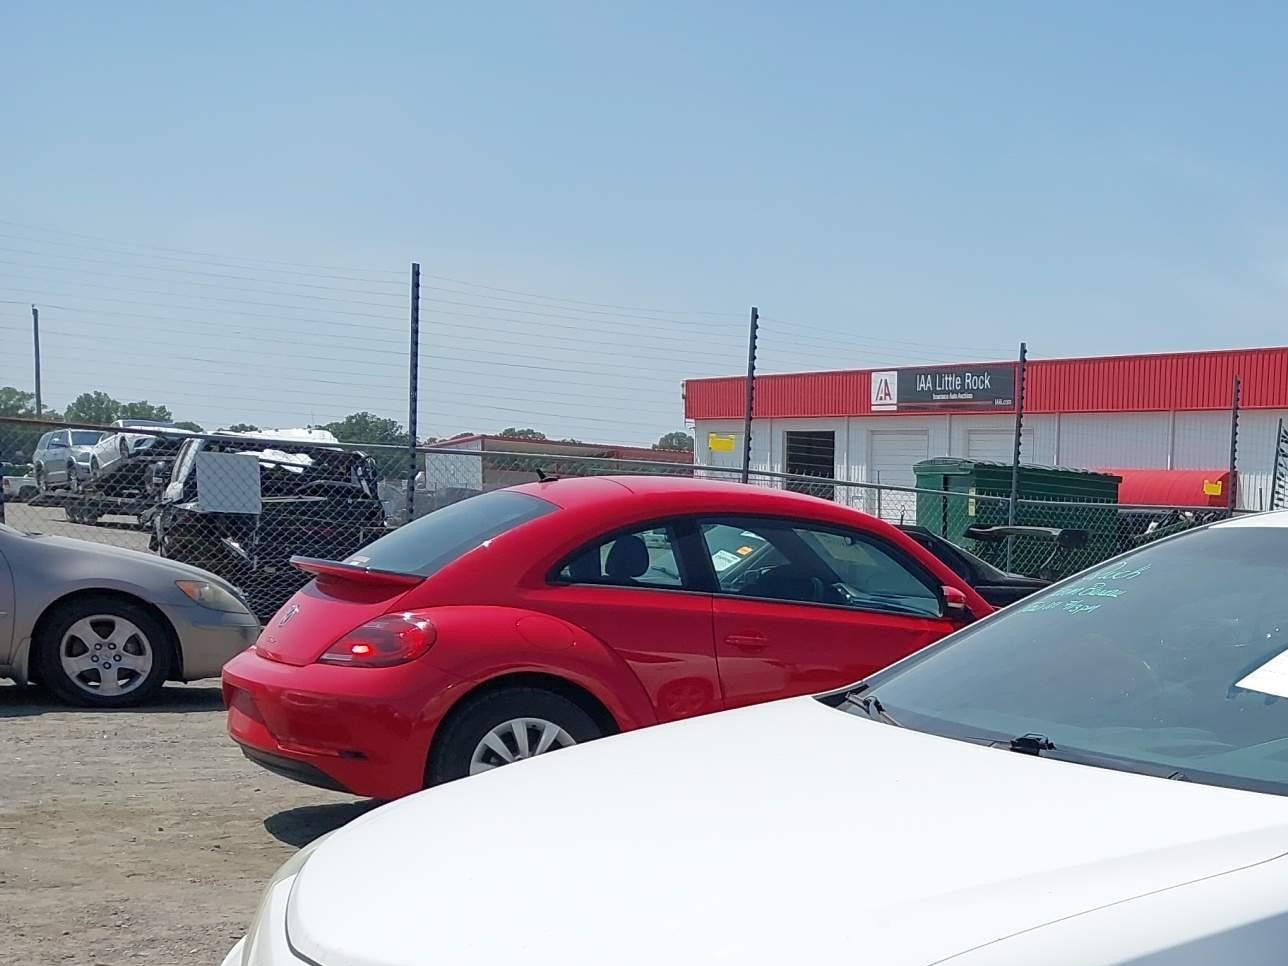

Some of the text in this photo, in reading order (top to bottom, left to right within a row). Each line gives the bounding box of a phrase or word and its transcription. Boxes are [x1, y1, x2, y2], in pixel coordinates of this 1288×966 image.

[916, 371, 991, 391] IAA Little Rock
